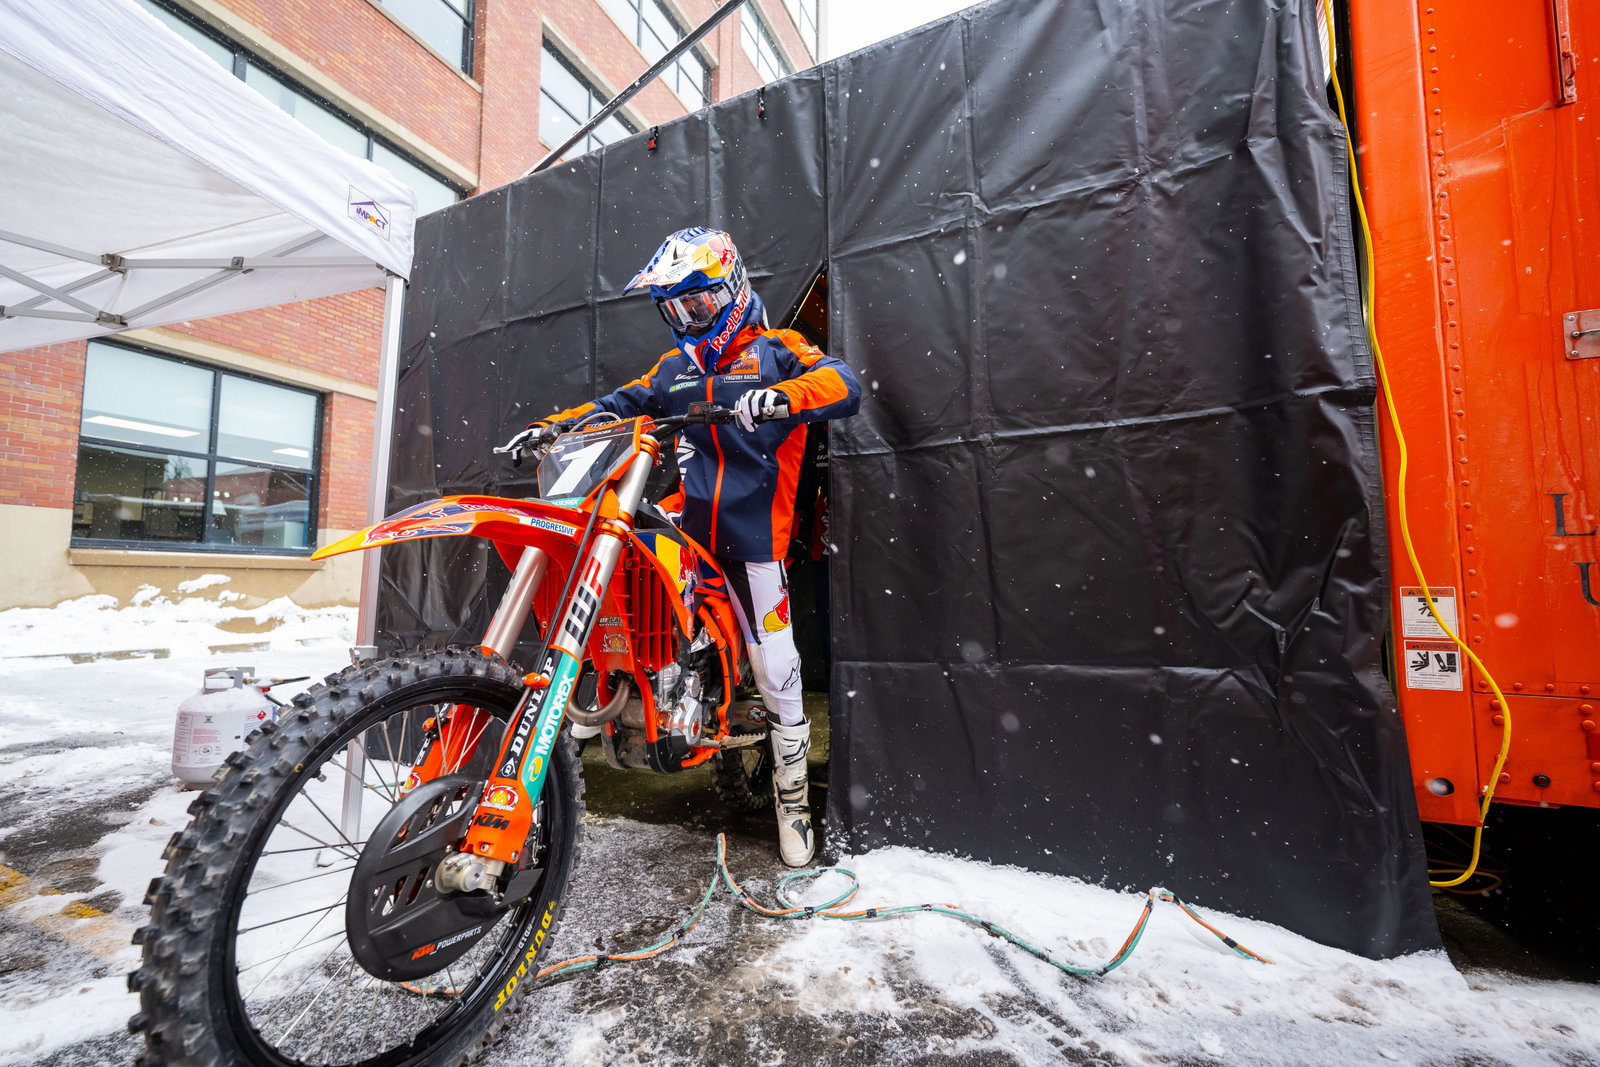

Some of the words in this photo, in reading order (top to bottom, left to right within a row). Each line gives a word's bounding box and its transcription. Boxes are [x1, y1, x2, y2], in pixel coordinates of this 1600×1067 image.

[711, 317, 737, 352] Red
[730, 290, 749, 324] Bull
[546, 439, 612, 497] 1
[531, 518, 574, 536] PROGRESSIVE
[534, 674, 575, 756] MOTOREX
[473, 812, 511, 831] KTM
[411, 944, 436, 961] KTM
[493, 909, 553, 1012] DUNLOP
